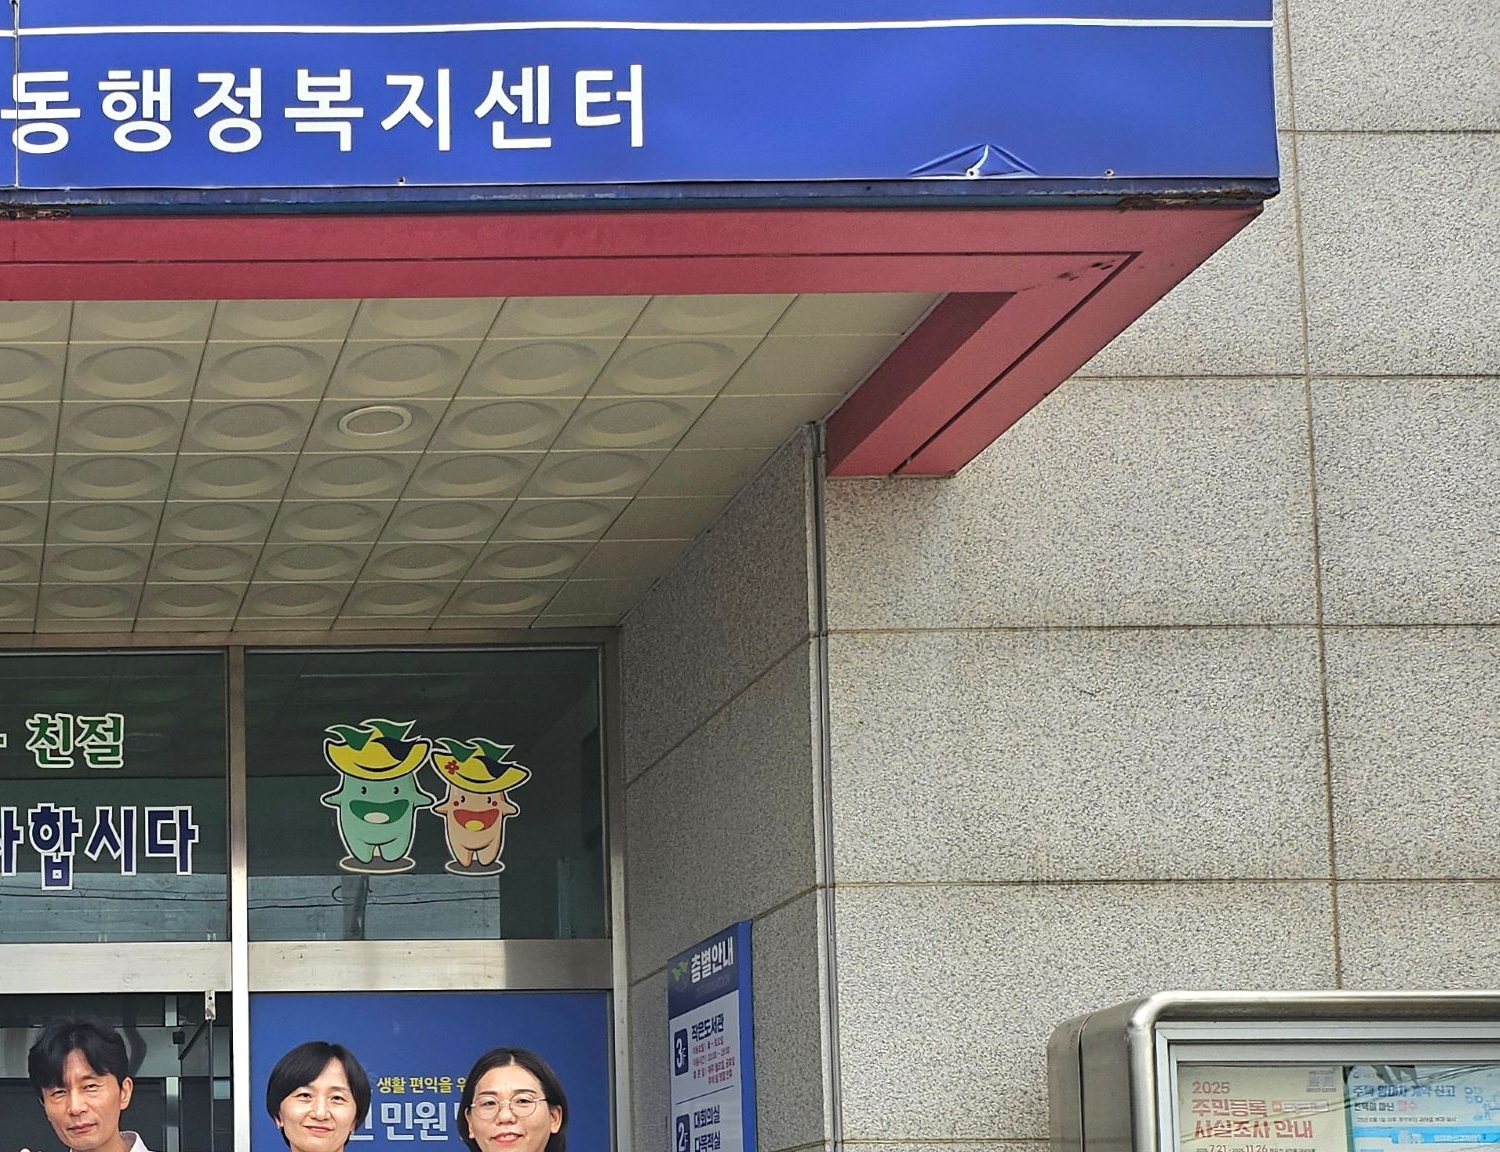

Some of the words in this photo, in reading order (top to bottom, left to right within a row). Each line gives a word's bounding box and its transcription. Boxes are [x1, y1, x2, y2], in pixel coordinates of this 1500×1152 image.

[26, 713, 125, 769] 친절
[691, 936, 734, 984] 층별안내
[376, 1076, 406, 1094] 생활
[409, 1076, 452, 1094] 편익을
[1192, 1081, 1230, 1094] 2025
[1192, 1099, 1268, 1117] 주민등록
[381, 1101, 449, 1141] 민원
[1195, 1120, 1270, 1138] 사실조사
[1273, 1120, 1313, 1138] 안내
